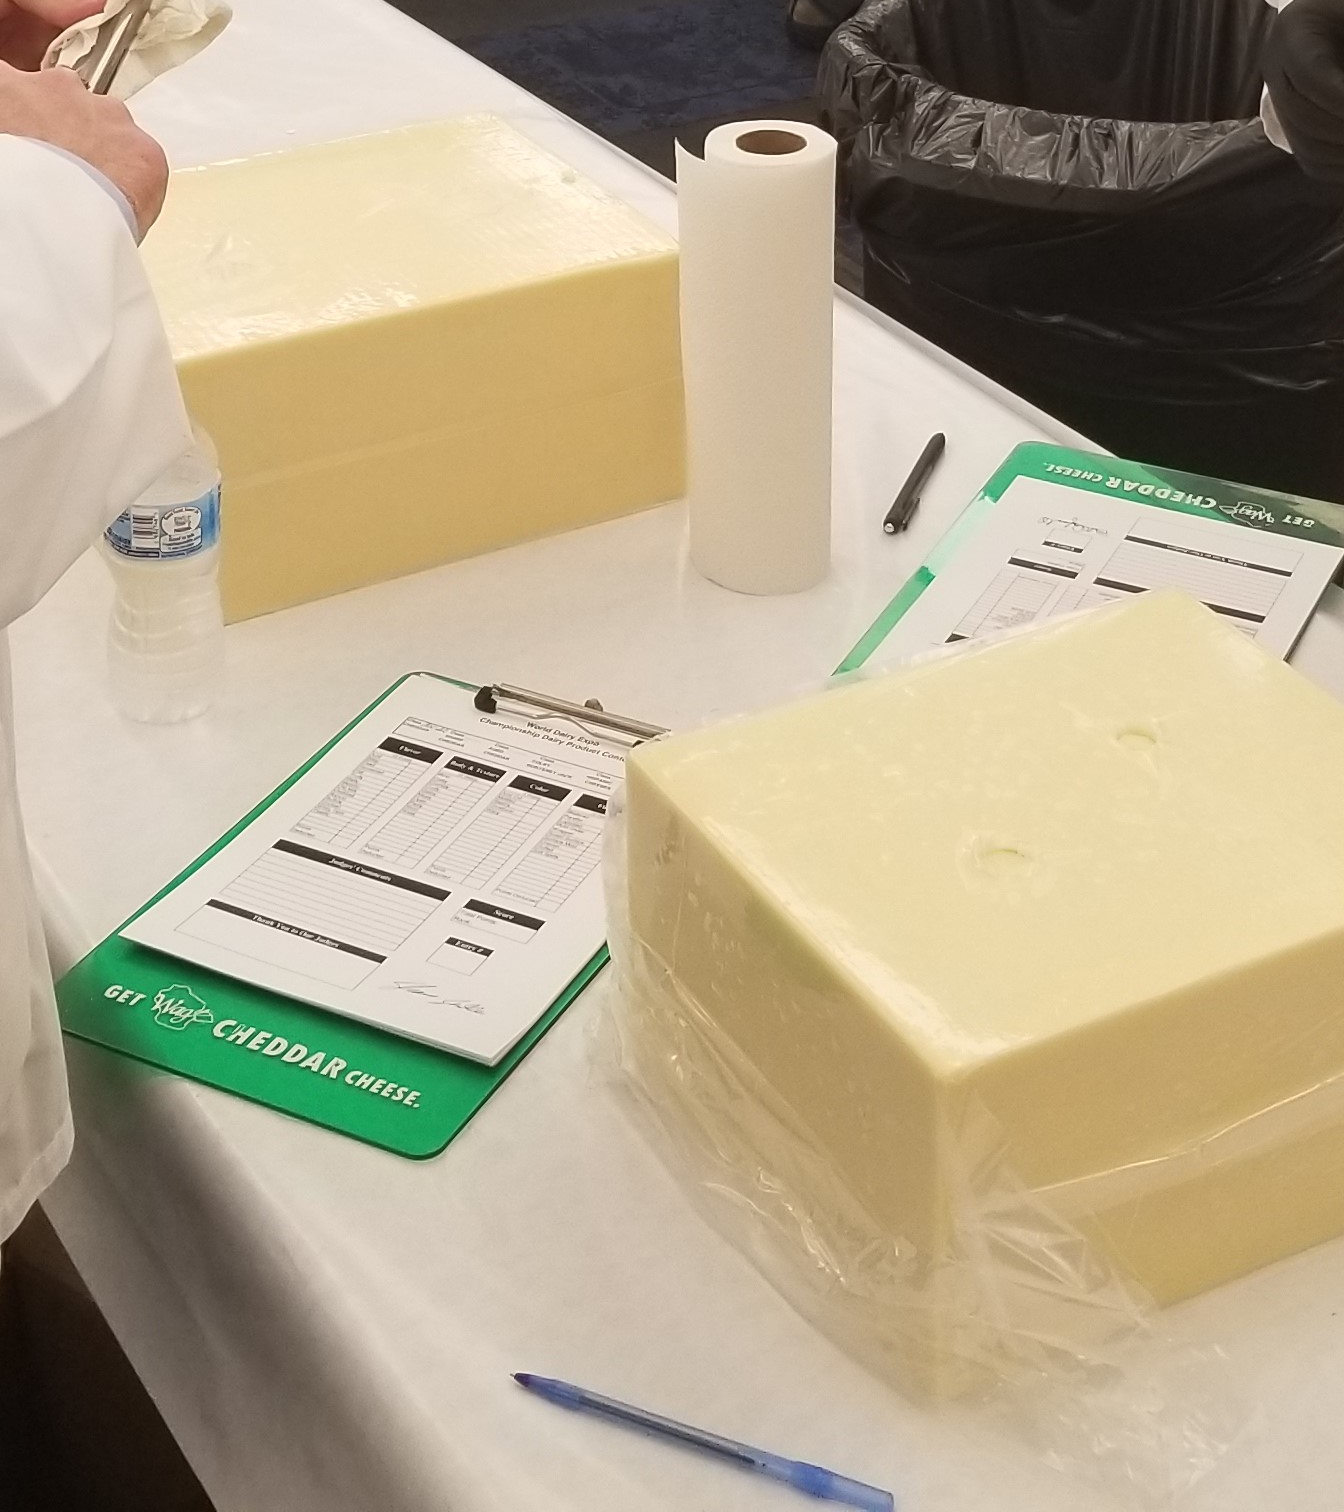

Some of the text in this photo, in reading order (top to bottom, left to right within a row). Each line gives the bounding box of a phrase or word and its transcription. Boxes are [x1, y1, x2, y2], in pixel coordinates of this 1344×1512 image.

[1105, 476, 1218, 509] CHEDDAR
[1281, 514, 1316, 528] GET
[479, 717, 541, 739] Championship
[542, 734, 565, 748] Dairy
[564, 740, 601, 756] Product
[526, 721, 600, 747] World Dairy Expo
[103, 984, 147, 1007] GET
[212, 1019, 348, 1080] CHEDDAR
[344, 1069, 422, 1109] CHEESE.
